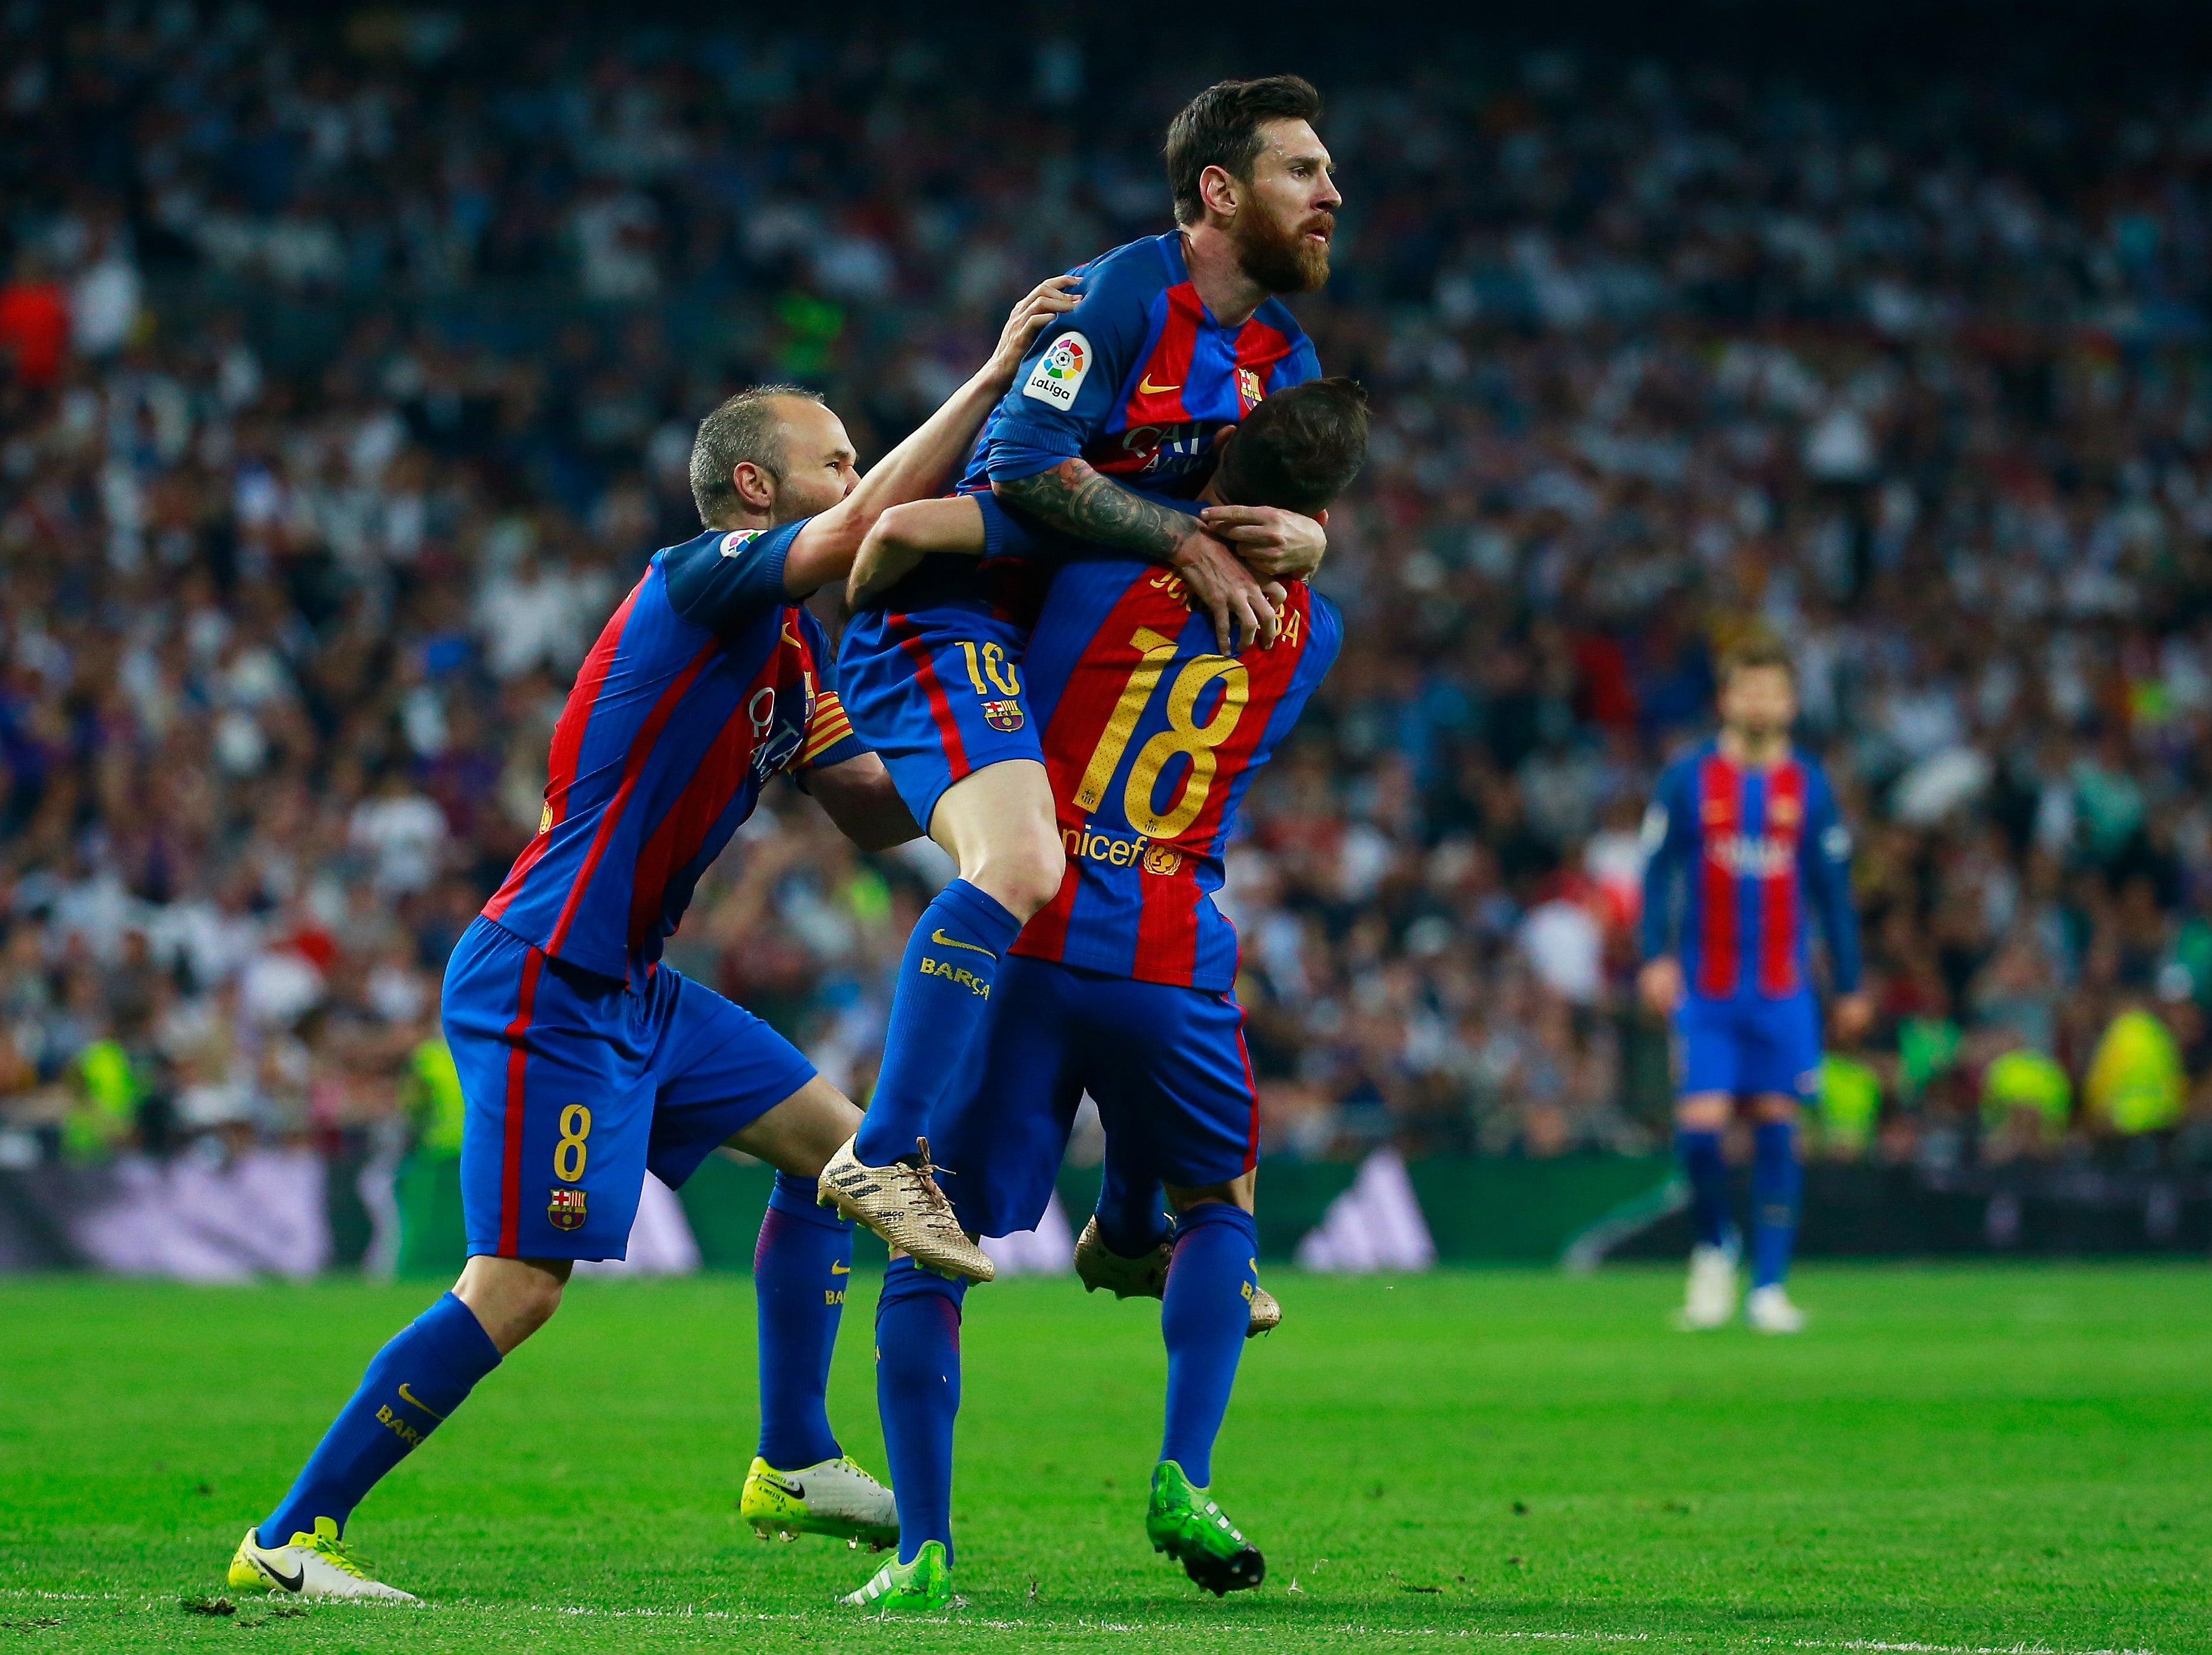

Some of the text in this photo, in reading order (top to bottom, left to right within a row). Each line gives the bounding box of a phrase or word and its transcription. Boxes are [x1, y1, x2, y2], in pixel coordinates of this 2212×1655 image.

[1031, 376, 1071, 400] LaLiga
[954, 642, 1021, 696] 10
[1072, 626, 1249, 840] 18
[1062, 824, 1148, 867] nicef
[553, 1103, 592, 1182] 8
